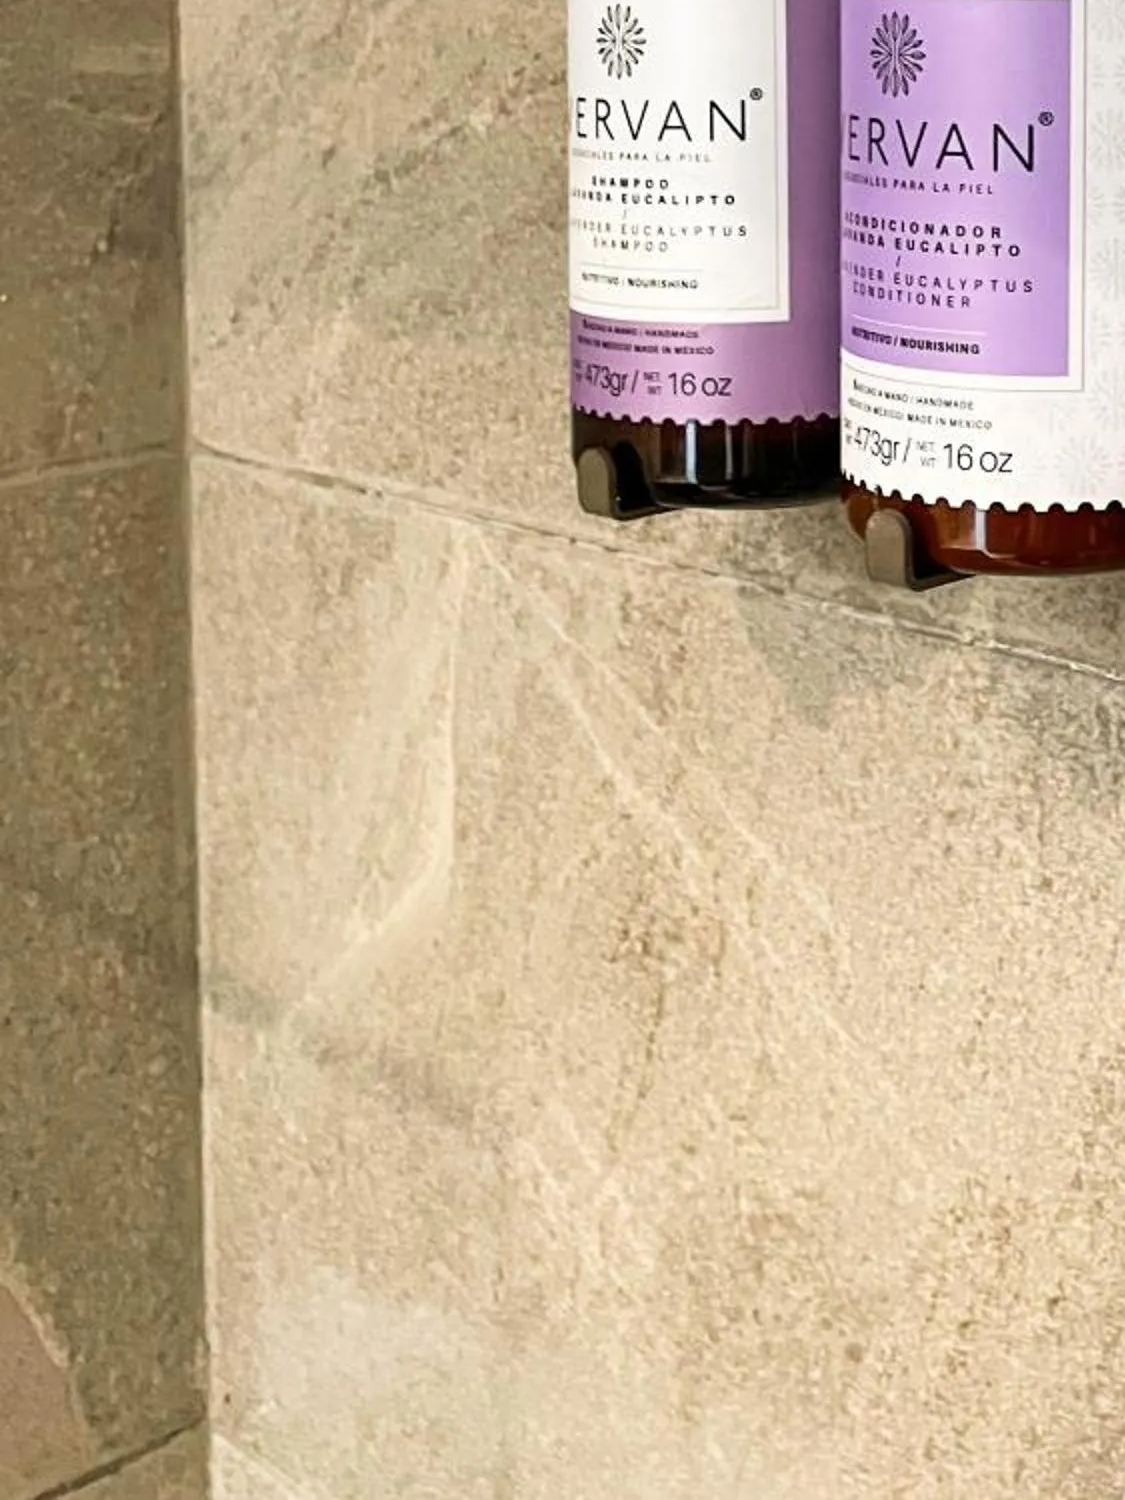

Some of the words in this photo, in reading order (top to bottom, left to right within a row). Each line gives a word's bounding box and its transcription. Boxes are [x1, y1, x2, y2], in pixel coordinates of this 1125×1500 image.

[592, 176, 669, 189] SHAMPOO
[893, 179, 925, 191] PARA
[933, 182, 950, 193] LA
[959, 183, 993, 195] PIEL
[621, 193, 735, 205] EUCALIPTO
[621, 225, 747, 236] EUCALYPTUS
[593, 238, 668, 252] SHAMPOO
[895, 237, 1021, 257] EUCALIPTO
[627, 278, 698, 289] NOURISHING
[893, 272, 1034, 293] EUCALYPTUS
[853, 280, 971, 308] CONDITIONER
[900, 338, 981, 355] NOURISHING
[586, 363, 628, 396] 473gr
[668, 372, 696, 397] 16
[701, 377, 732, 396] oz
[916, 394, 974, 410] HANDMADE
[907, 413, 933, 424] MADE
[935, 416, 947, 426] IN
[854, 427, 900, 466] 473gr
[943, 443, 973, 471] 16
[979, 451, 1013, 473] oz
